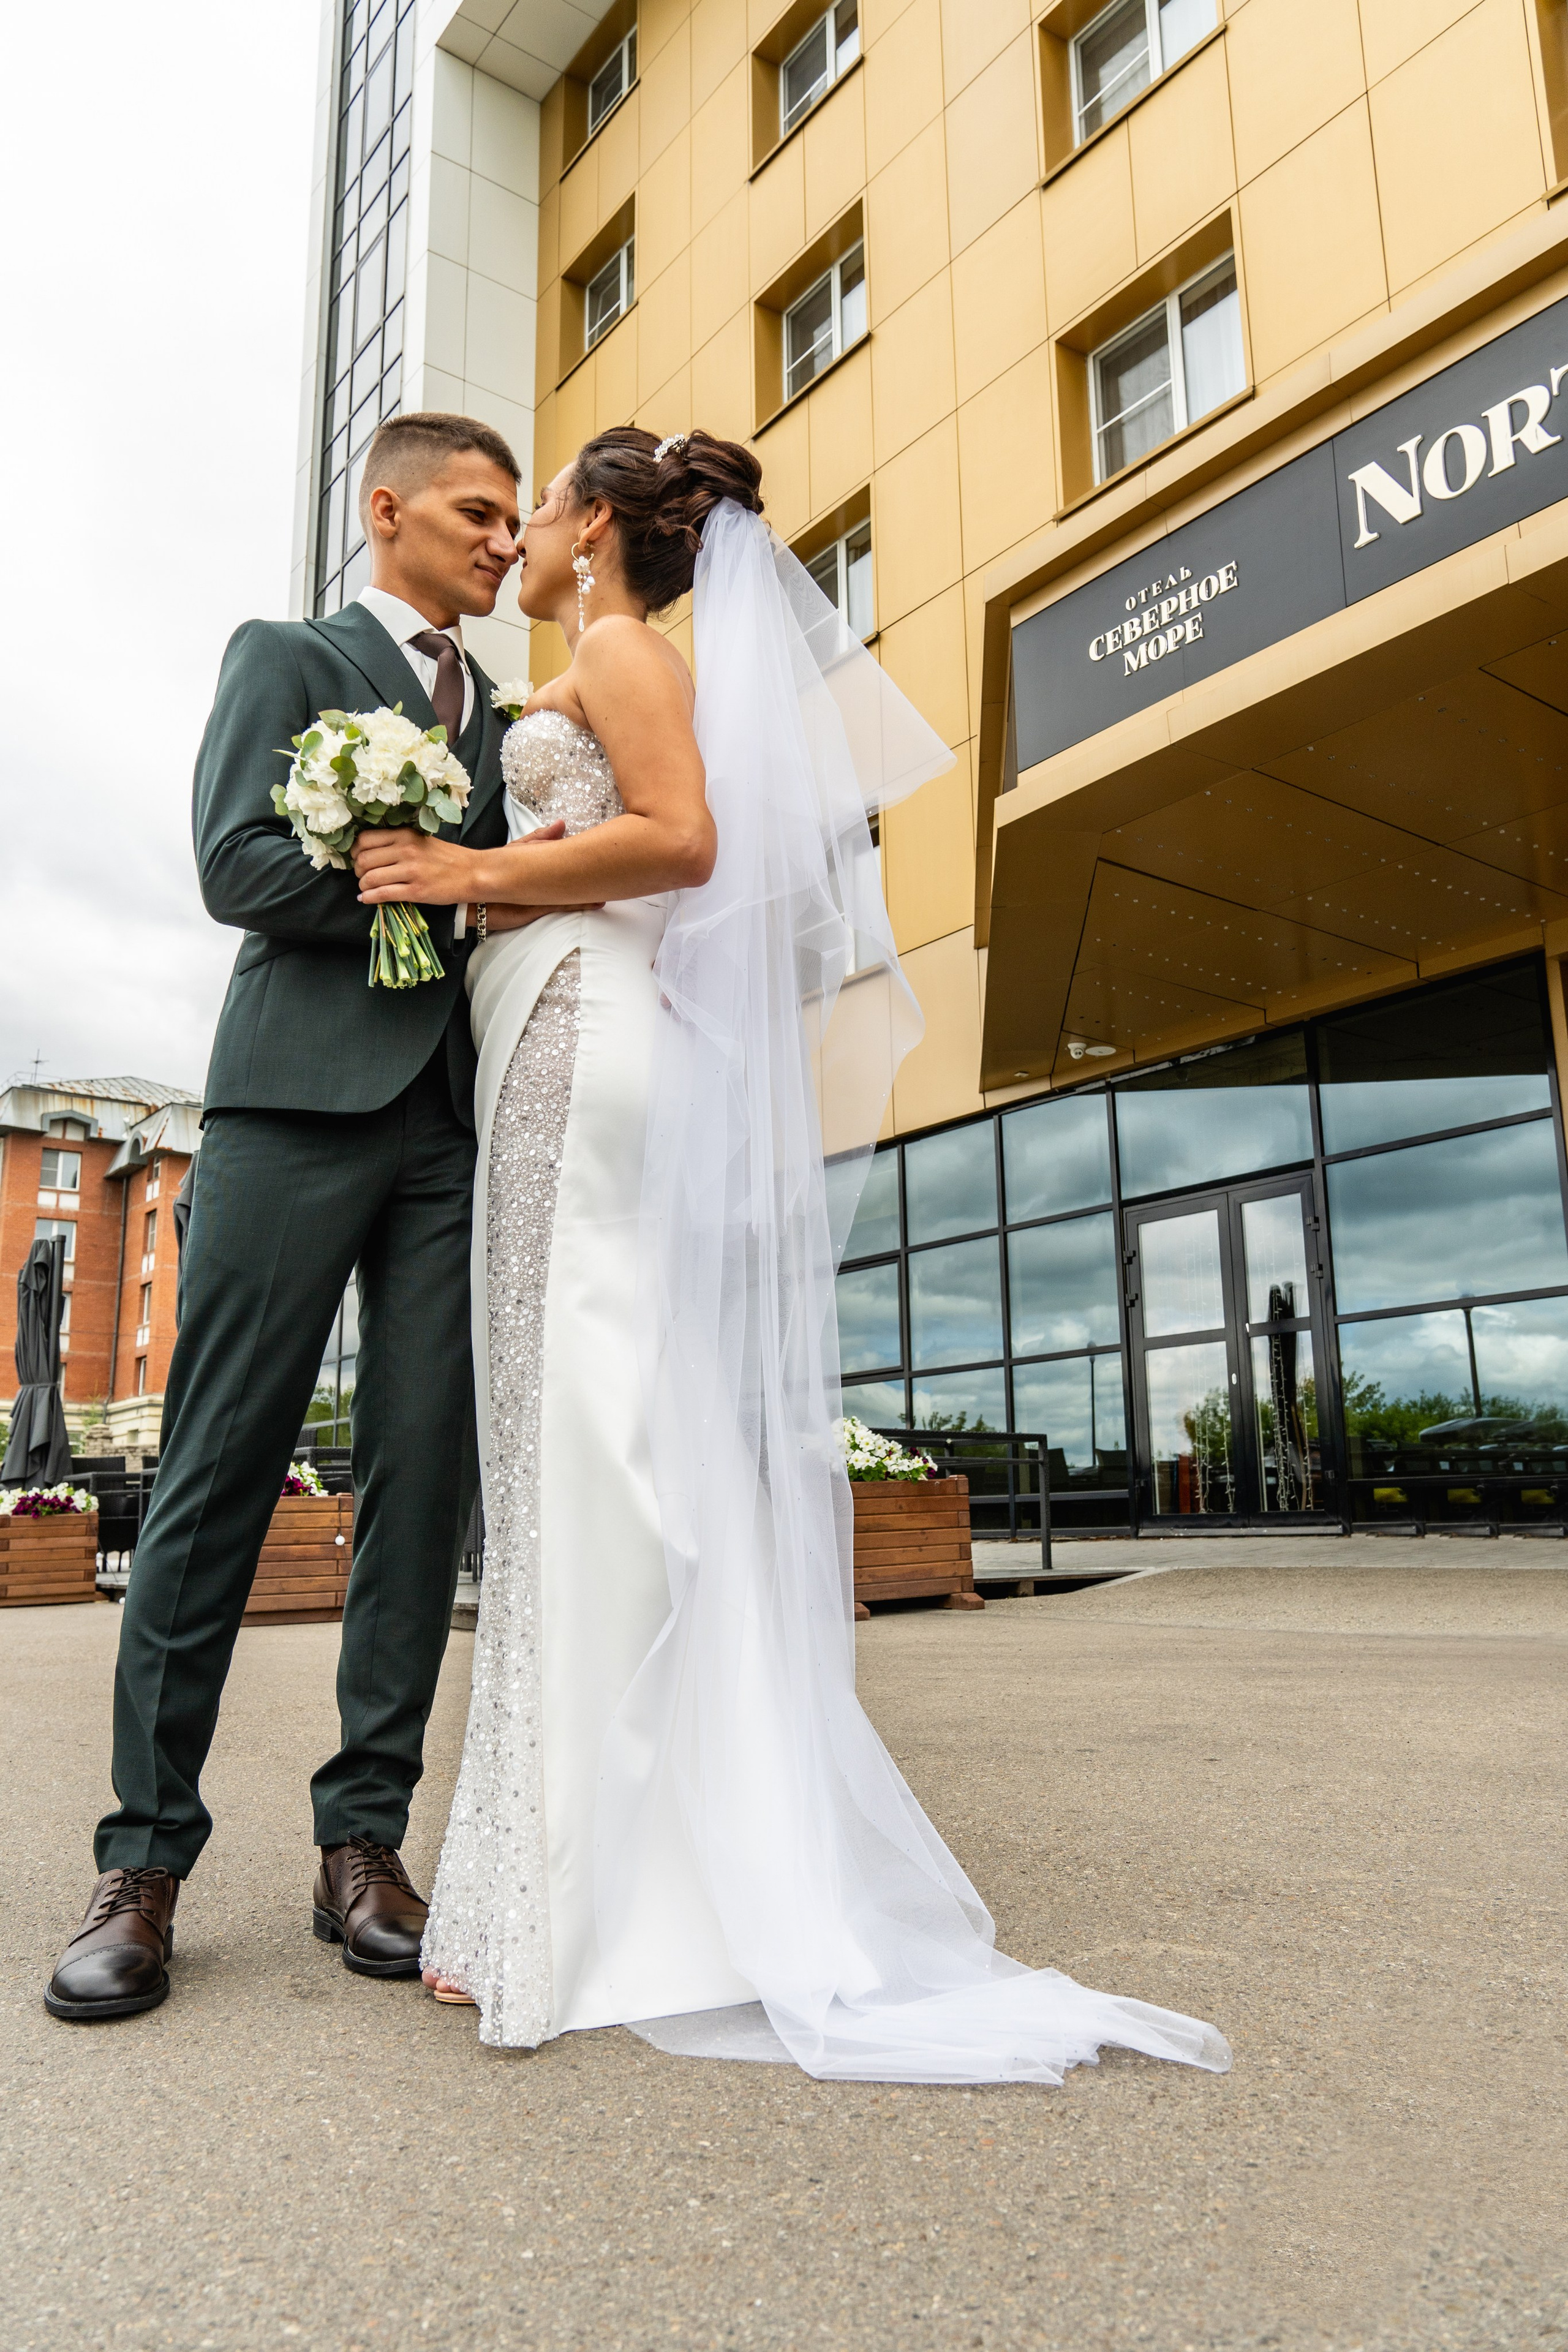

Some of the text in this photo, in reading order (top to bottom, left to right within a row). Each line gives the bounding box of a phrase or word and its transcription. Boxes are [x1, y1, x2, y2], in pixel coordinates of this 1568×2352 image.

[1088, 560, 1239, 662] СЕВЕРНОЕ
[1125, 566, 1193, 612] ОТЕЛЬ
[1122, 611, 1204, 676] МОРЕ
